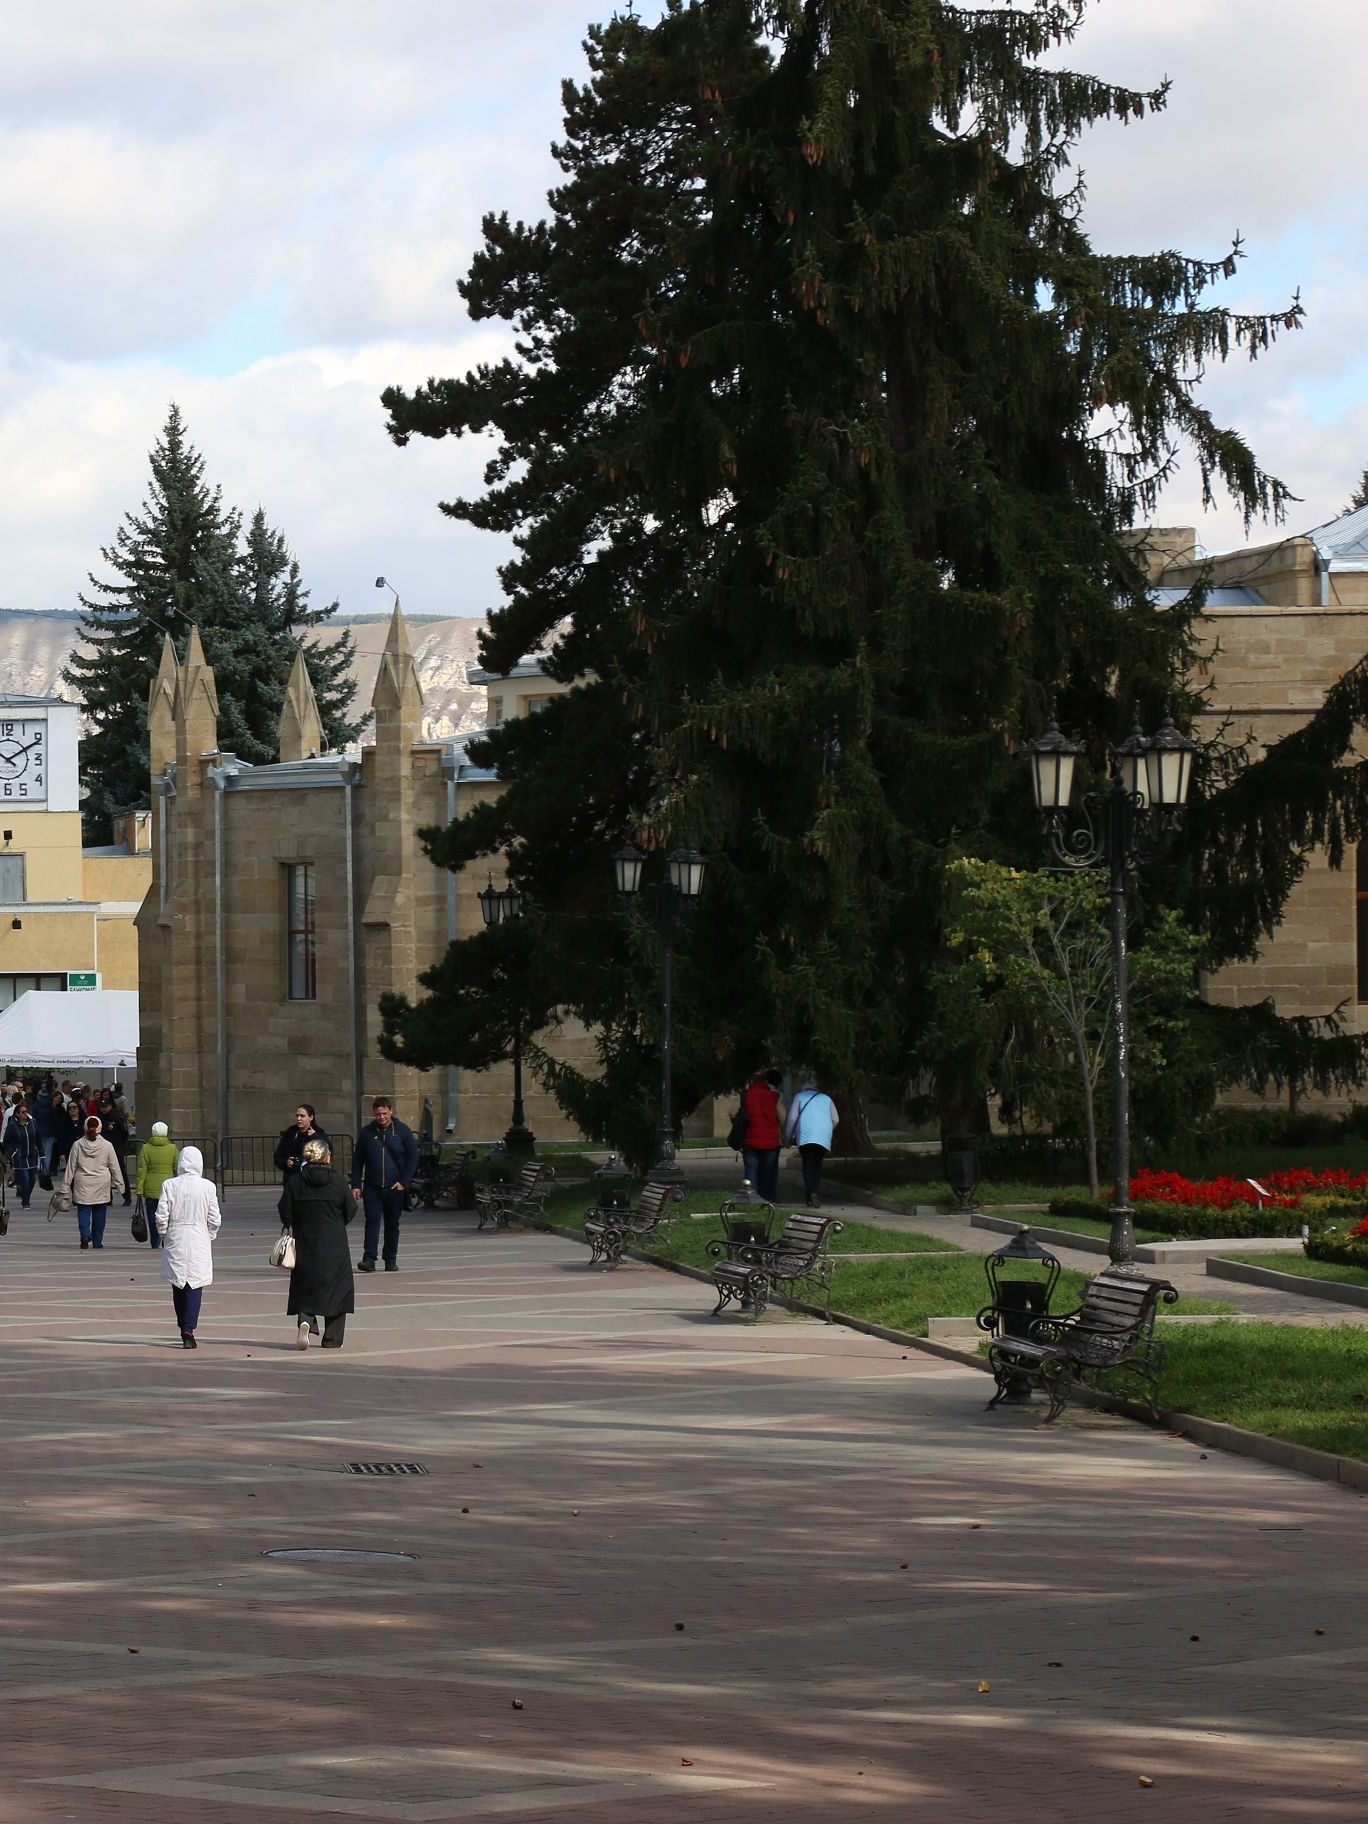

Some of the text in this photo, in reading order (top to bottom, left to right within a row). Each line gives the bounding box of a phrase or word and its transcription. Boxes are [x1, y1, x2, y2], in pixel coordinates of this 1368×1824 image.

[1, 723, 14, 737] 12
[34, 732, 43, 746] 2
[34, 753, 43, 766] 3
[35, 774, 43, 787] 4
[4, 783, 13, 796] 6
[19, 783, 28, 796] 5
